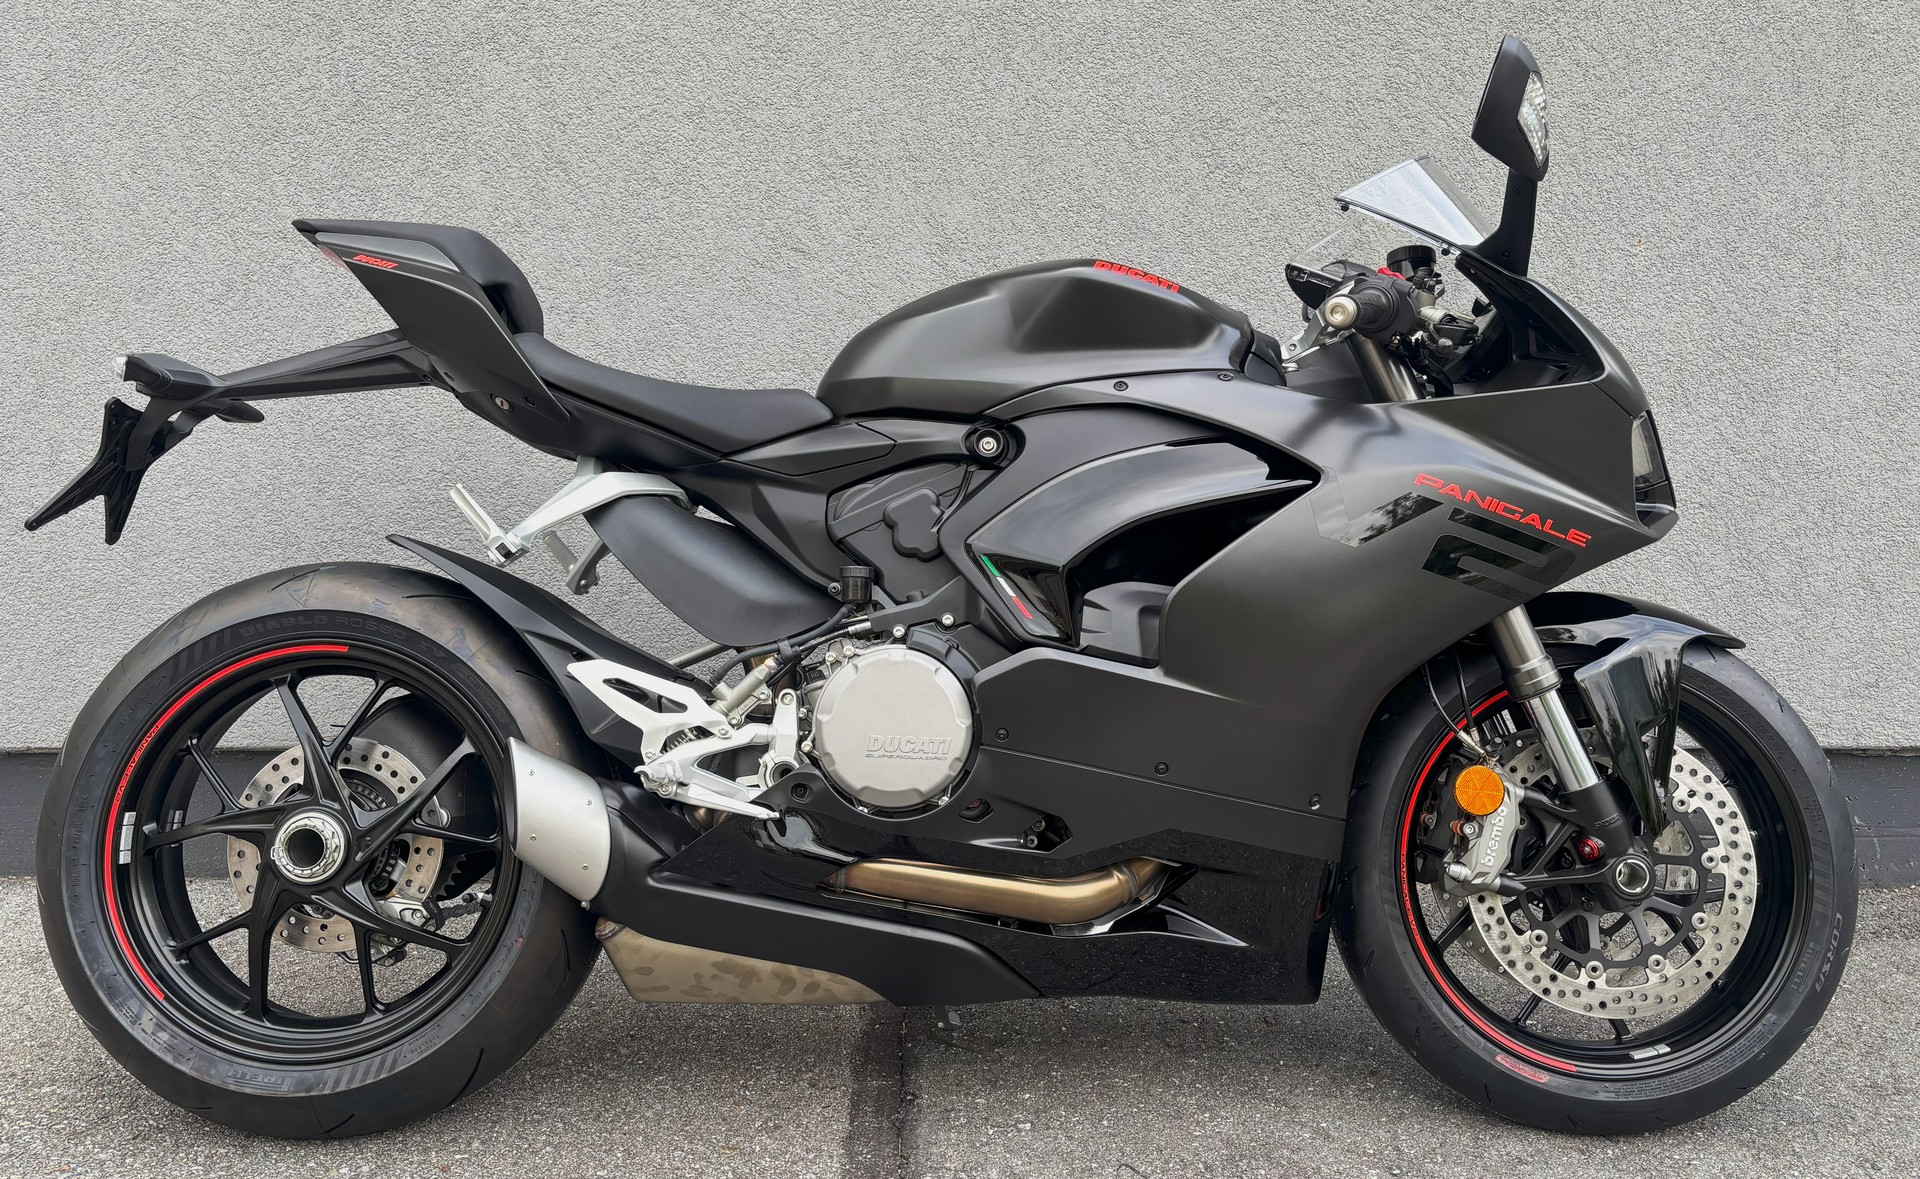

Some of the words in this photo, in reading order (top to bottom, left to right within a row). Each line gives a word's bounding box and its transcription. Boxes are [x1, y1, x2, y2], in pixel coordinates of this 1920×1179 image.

[353, 254, 399, 269] DUCATI
[1093, 260, 1180, 294] DUCATI
[1413, 472, 1592, 548] PANIGALE
[238, 614, 329, 638] DIABLO
[336, 614, 407, 640] ROSSO
[865, 753, 948, 761] SUPERQUADRO
[866, 735, 952, 754] DUCATI
[1481, 804, 1508, 868] brembo
[1790, 941, 1821, 994] PIRELLI
[1814, 912, 1843, 993] CORSA
[226, 1066, 293, 1092] PIRELLI
